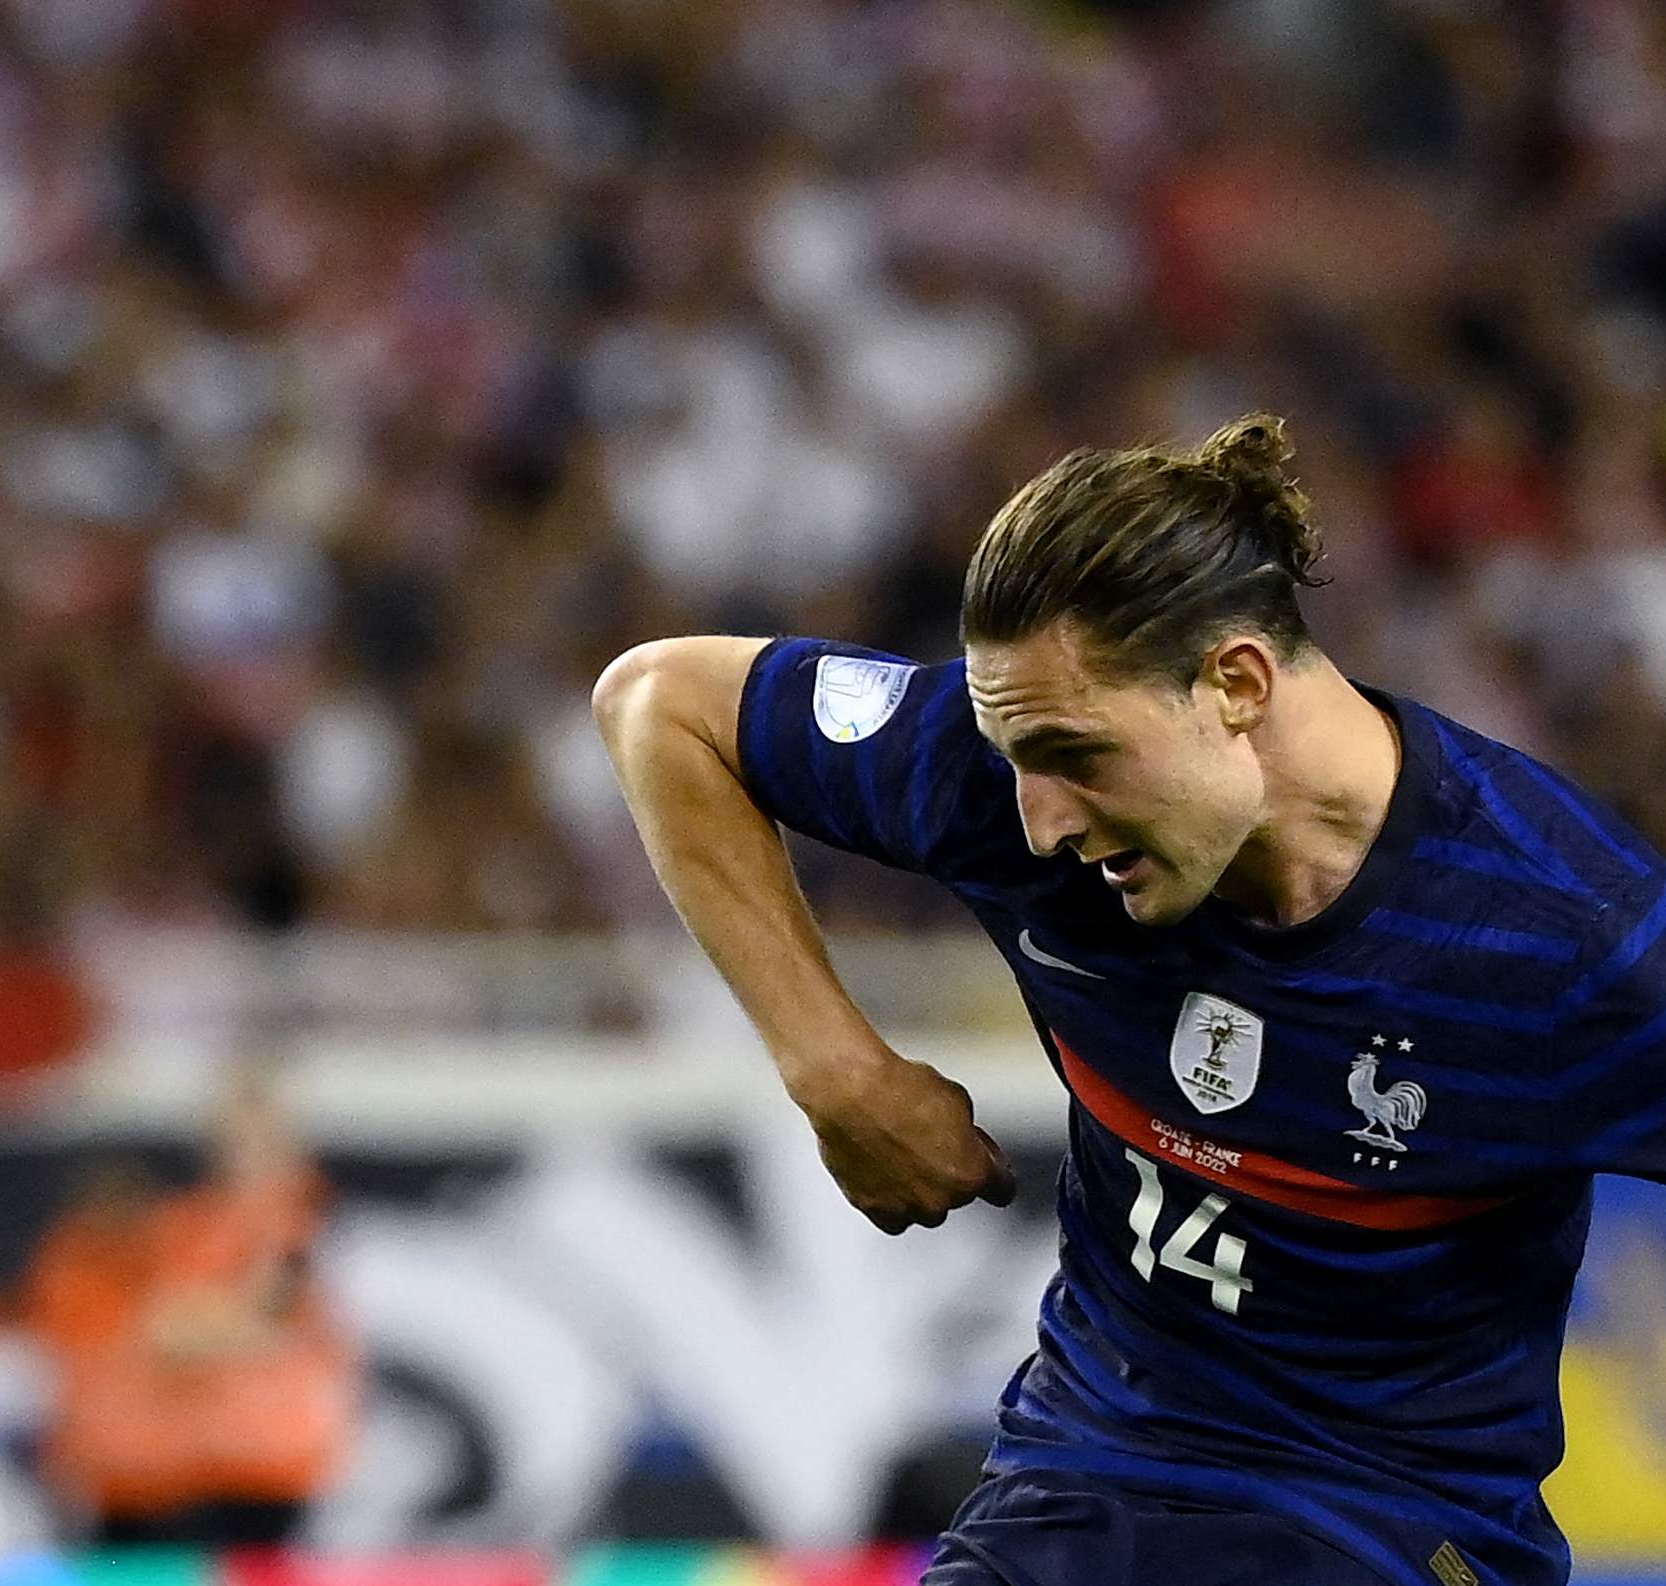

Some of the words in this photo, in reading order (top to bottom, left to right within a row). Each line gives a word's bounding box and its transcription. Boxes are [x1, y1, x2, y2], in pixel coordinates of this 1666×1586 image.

[1193, 1066, 1230, 1091] FIFA
[1158, 1136, 1169, 1149] 6
[1194, 1150, 1228, 1175] 2022
[1202, 1140, 1243, 1168] FRANCE
[1125, 1147, 1254, 1316] 14
